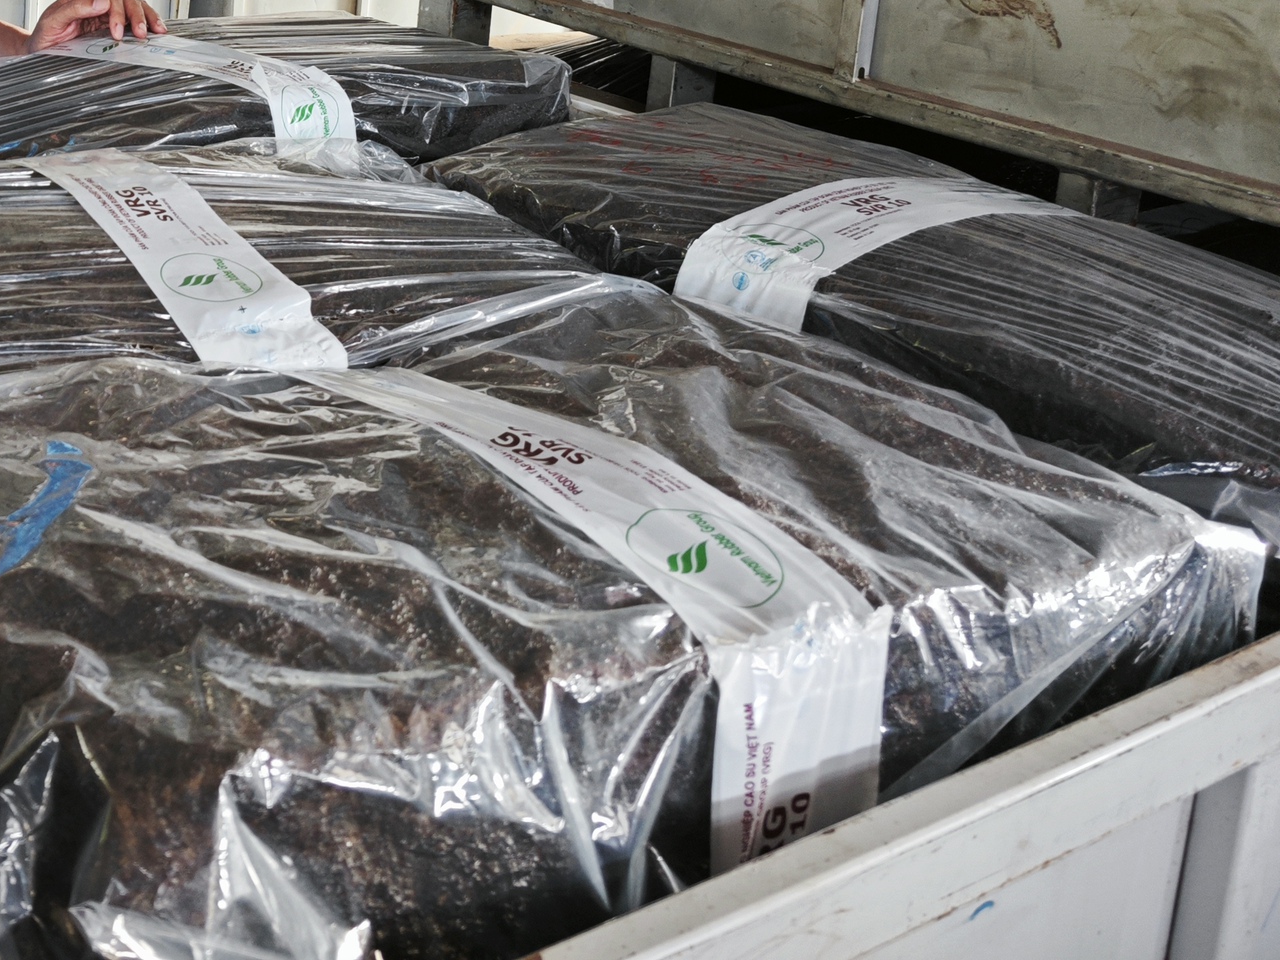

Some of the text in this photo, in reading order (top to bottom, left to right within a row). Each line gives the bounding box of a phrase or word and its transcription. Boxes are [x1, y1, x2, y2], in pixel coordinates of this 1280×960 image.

[115, 189, 152, 218] VRG
[132, 185, 174, 222] SVR 10
[840, 193, 891, 209] VRG
[855, 198, 912, 216] SVR 10
[490, 431, 559, 466] VRG
[541, 439, 593, 466] SVR
[687, 512, 777, 587] Vietnam Rubber Group
[743, 702, 754, 731] NAM
[743, 762, 757, 778] SU
[760, 740, 774, 774] (VRG)
[743, 780, 757, 807] CAO
[788, 790, 811, 836] 10
